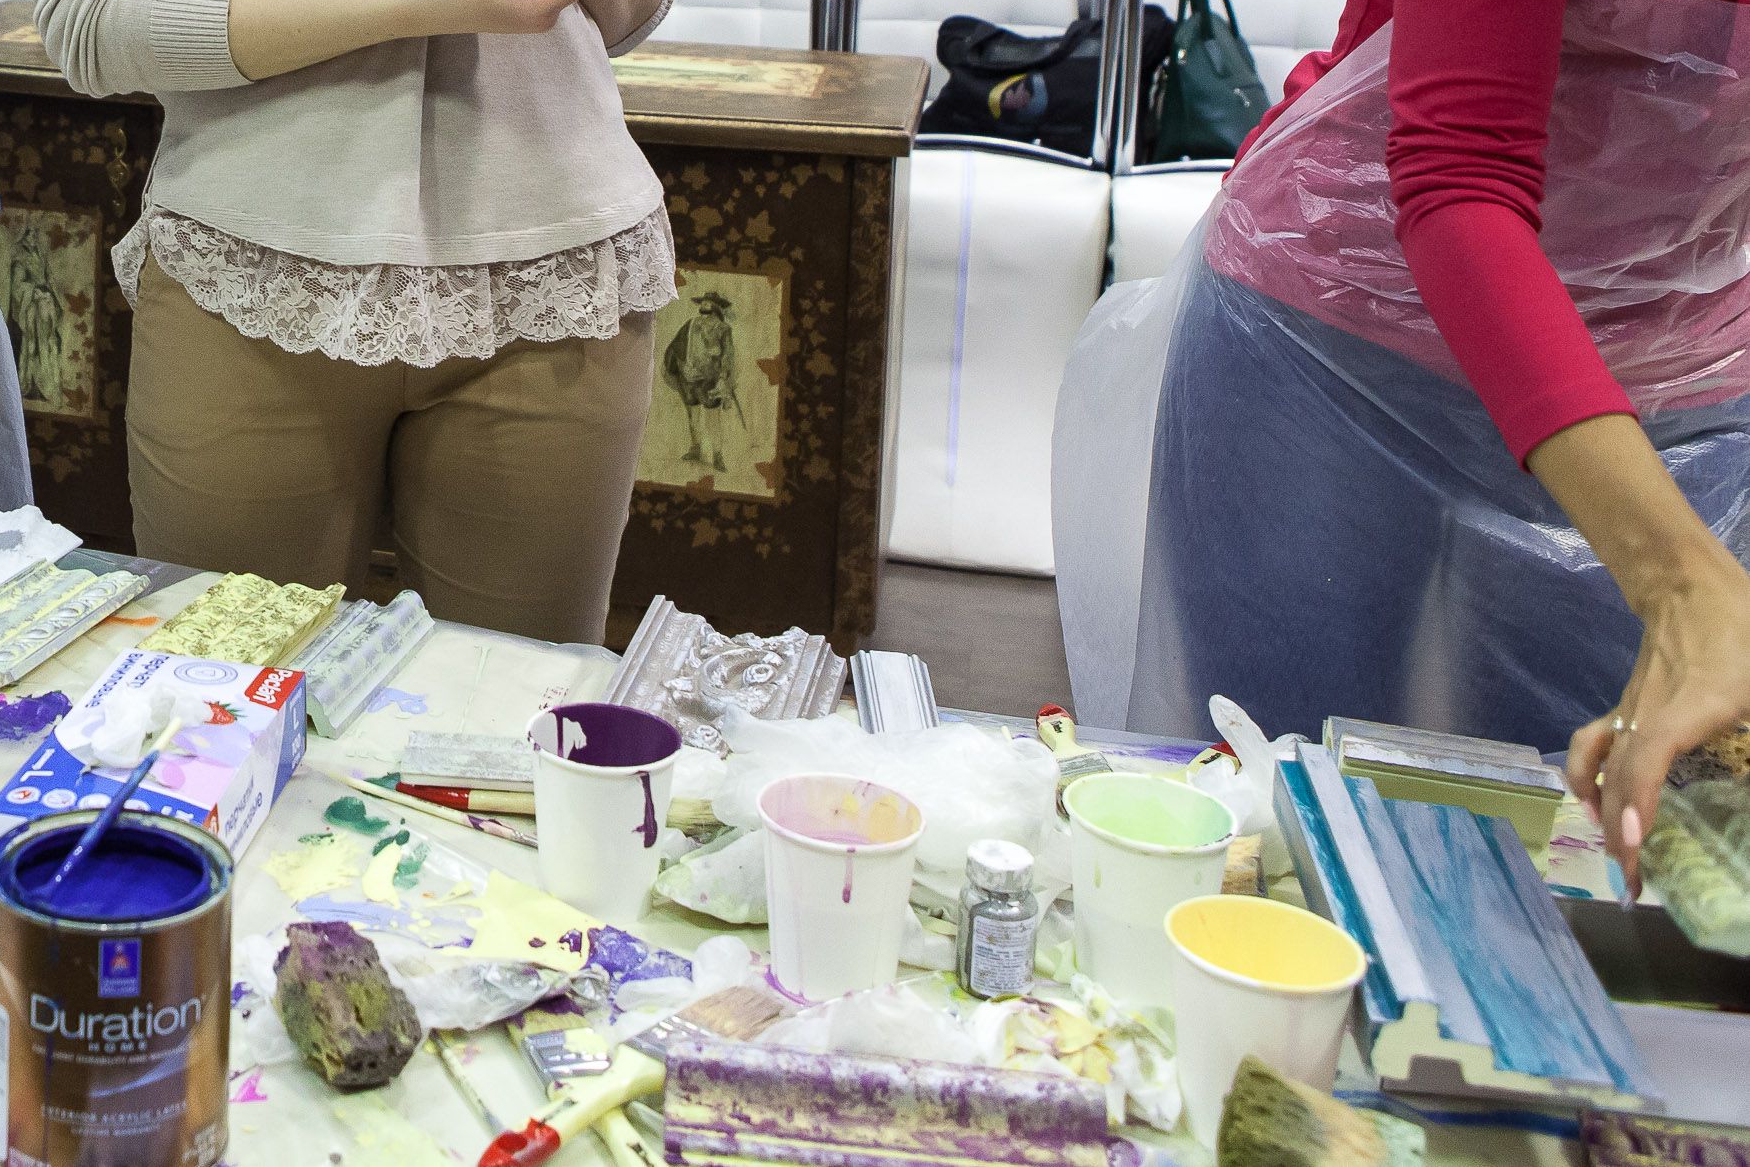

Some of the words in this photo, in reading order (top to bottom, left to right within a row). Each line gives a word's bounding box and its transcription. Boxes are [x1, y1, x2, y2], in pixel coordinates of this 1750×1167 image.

[128, 654, 170, 689] перчат
[253, 668, 294, 704] Paclan
[30, 993, 201, 1041] Duration
[88, 1041, 148, 1053] HOME
